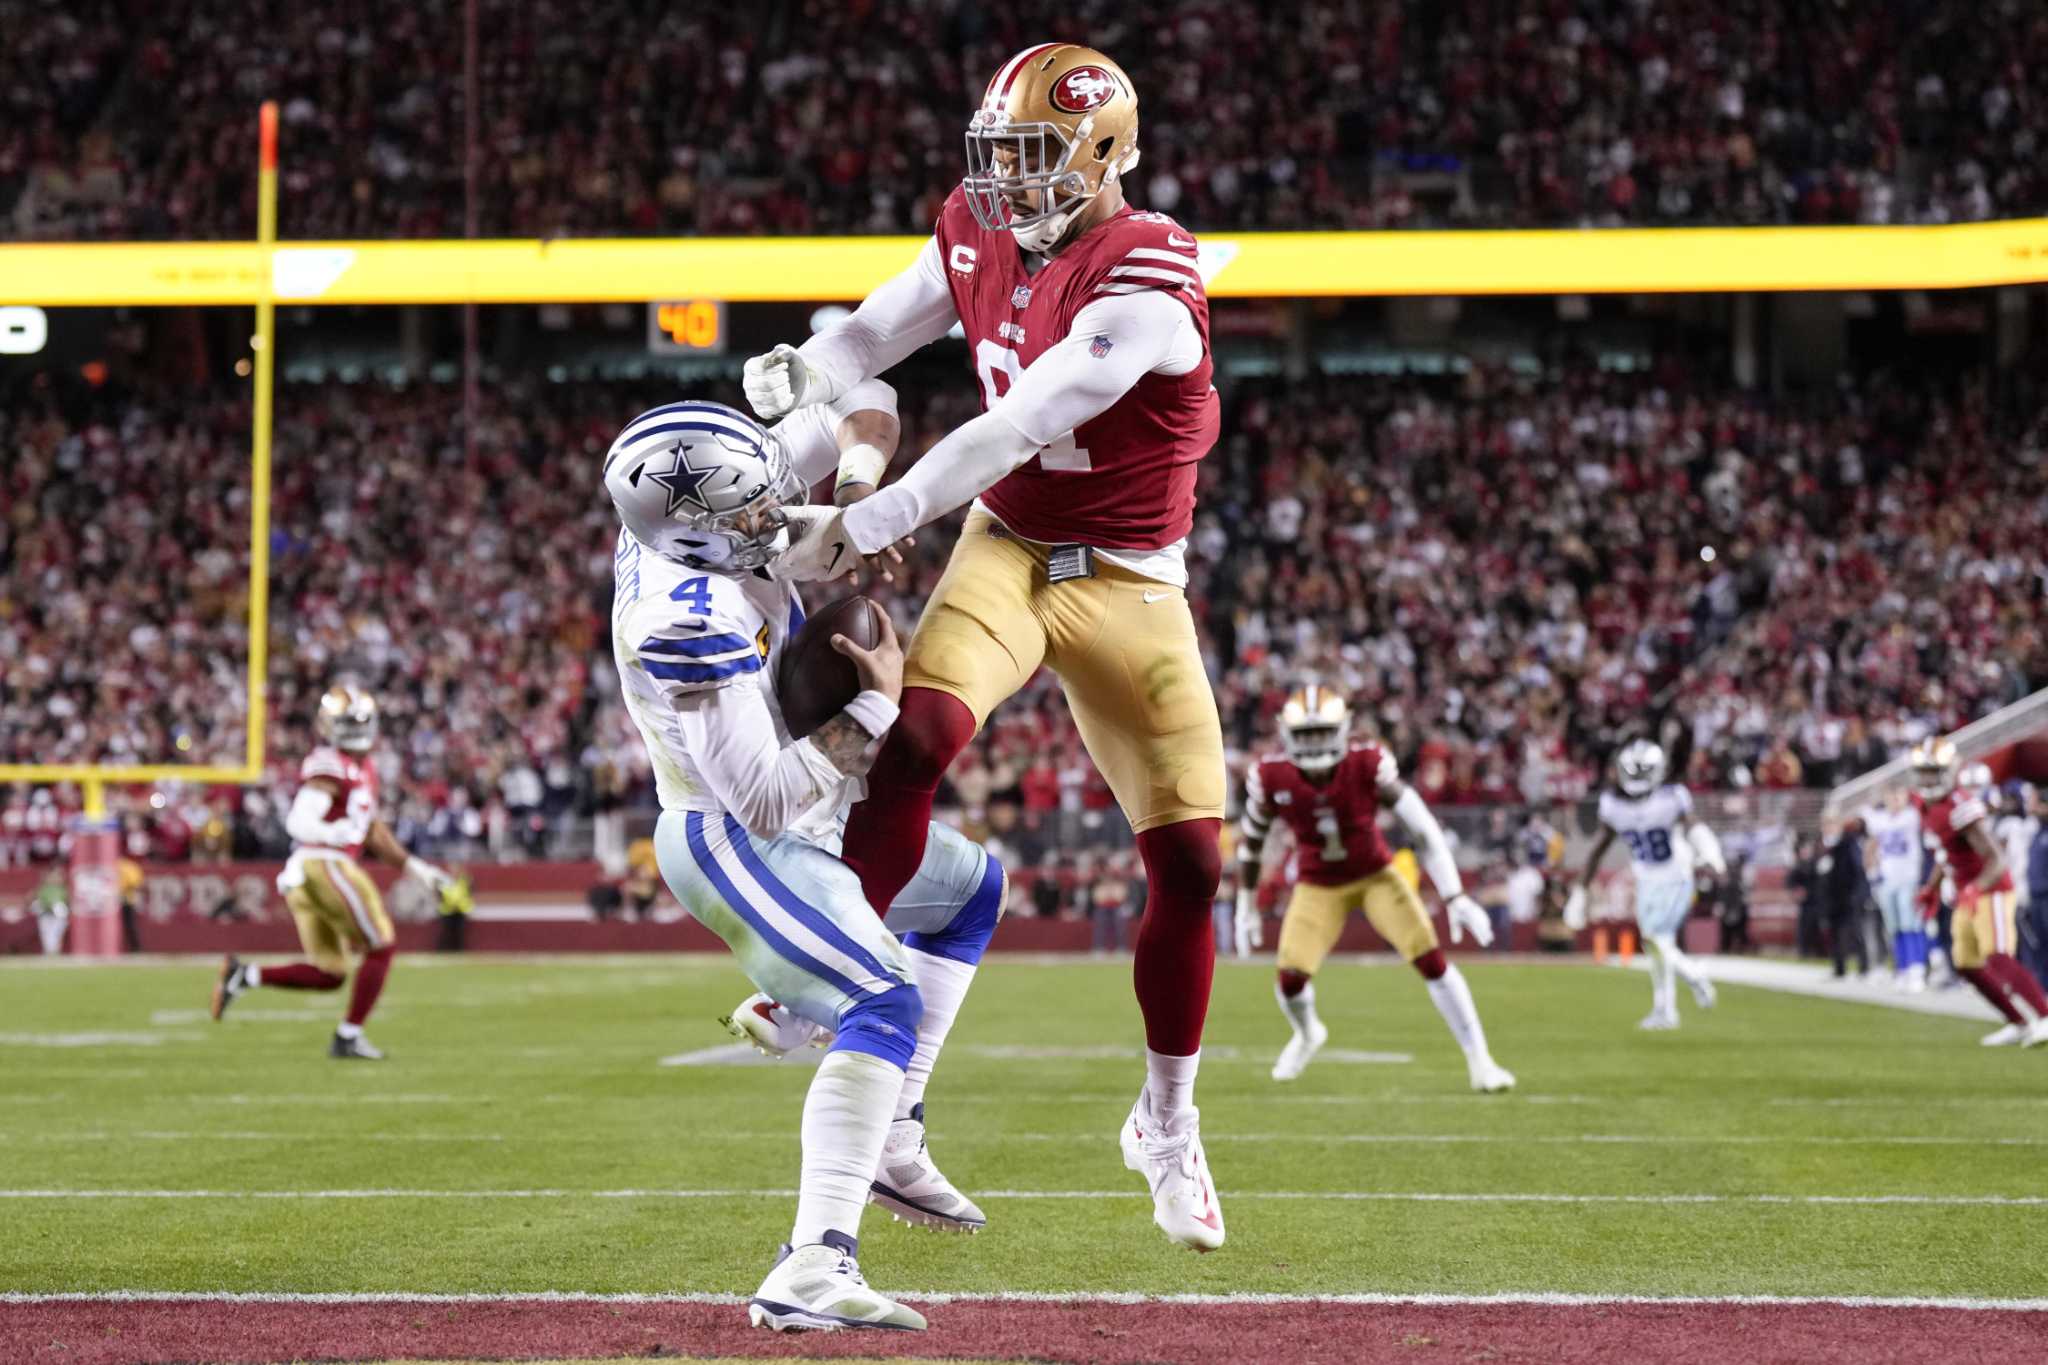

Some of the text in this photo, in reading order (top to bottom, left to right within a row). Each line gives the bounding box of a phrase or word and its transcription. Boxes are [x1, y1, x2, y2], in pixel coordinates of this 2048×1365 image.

[1066, 70, 1106, 108] SF
[950, 244, 976, 273] C
[657, 301, 719, 348] 40
[669, 576, 712, 616] 4
[1313, 807, 1347, 862] 1
